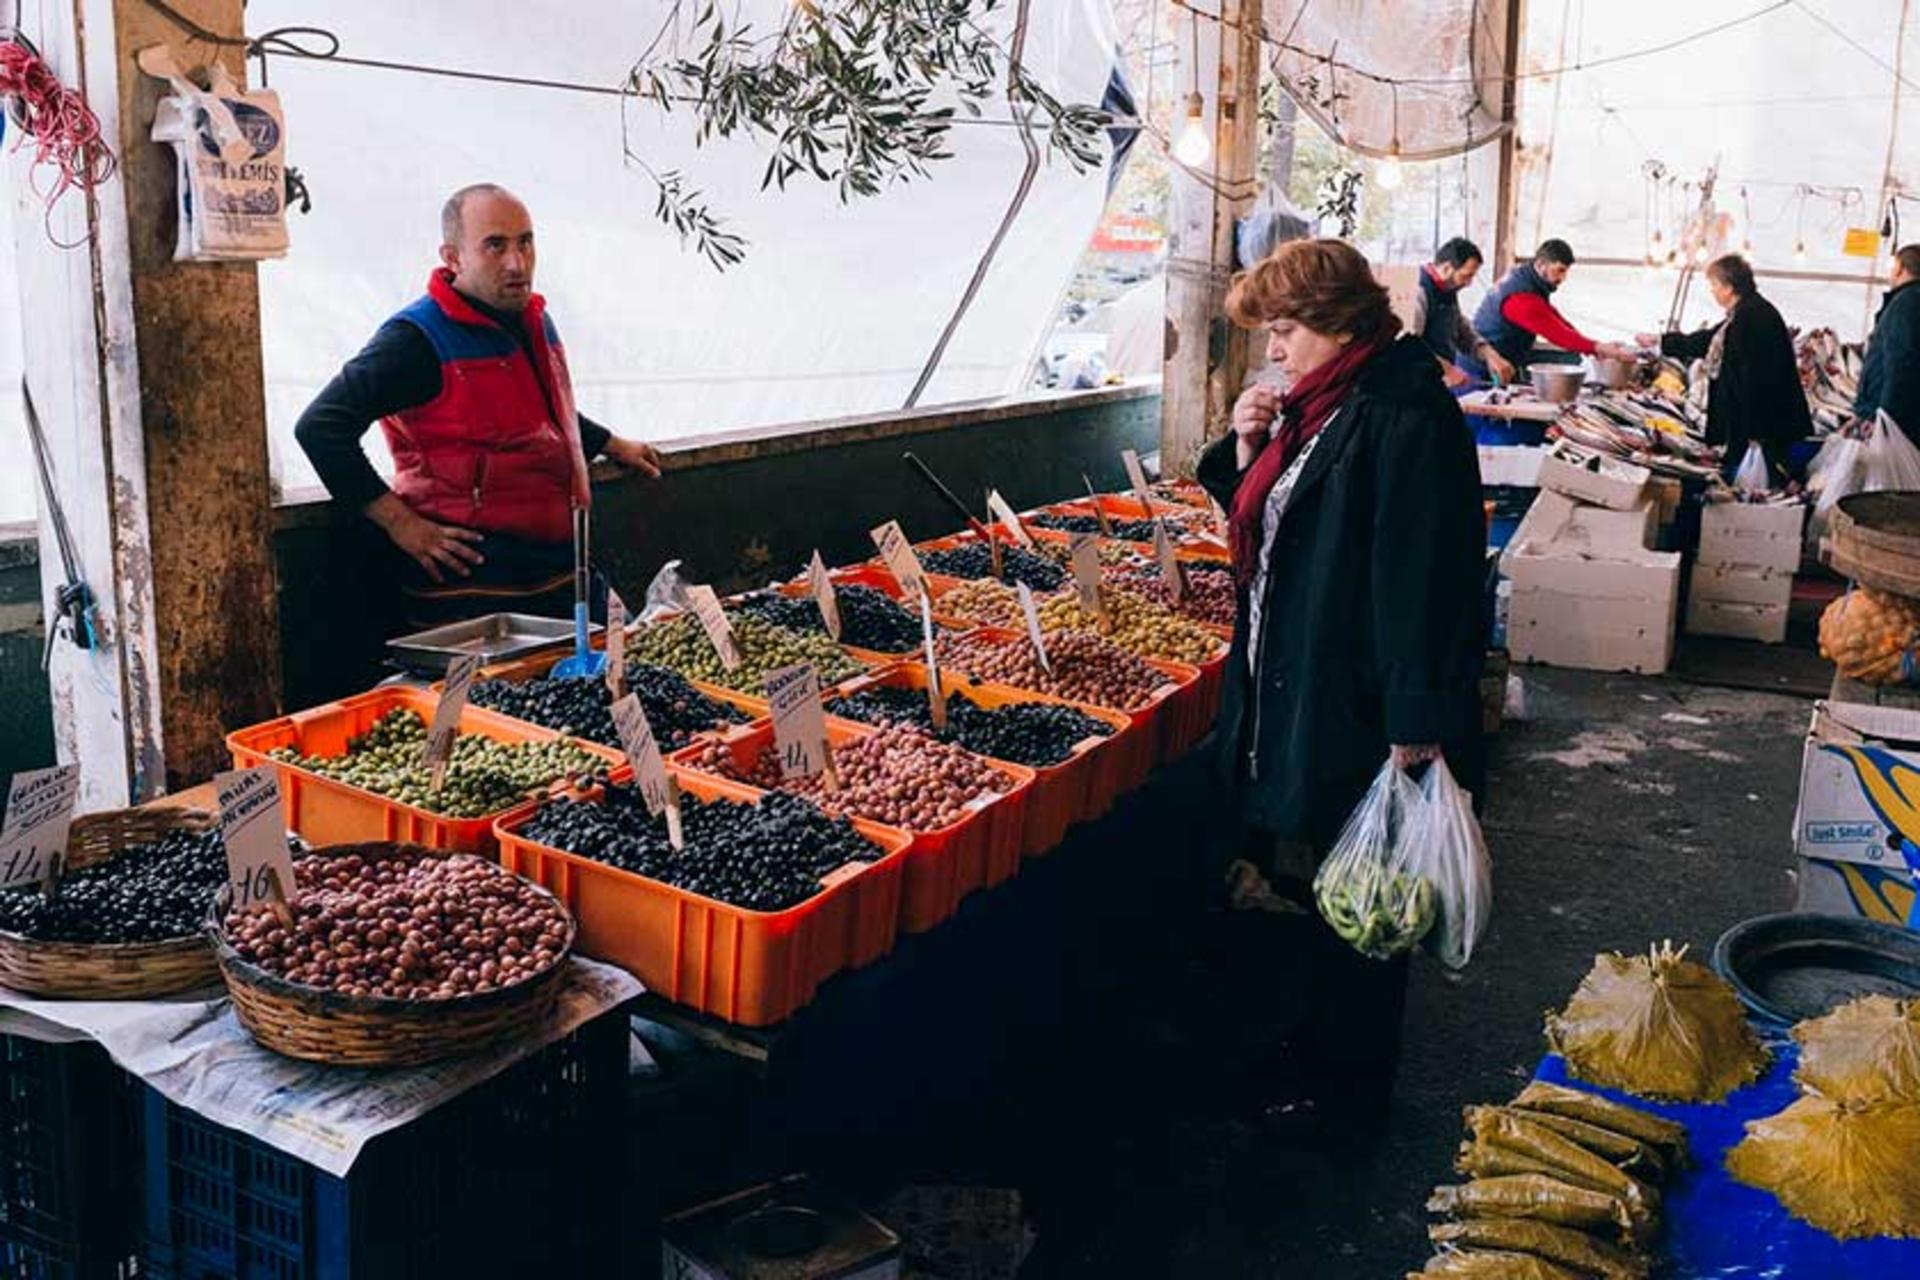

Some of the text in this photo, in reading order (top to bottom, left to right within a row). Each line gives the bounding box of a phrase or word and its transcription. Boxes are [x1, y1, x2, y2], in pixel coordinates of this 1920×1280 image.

[781, 742, 808, 773] 14
[3, 845, 40, 882] 14
[237, 862, 270, 905] 16
